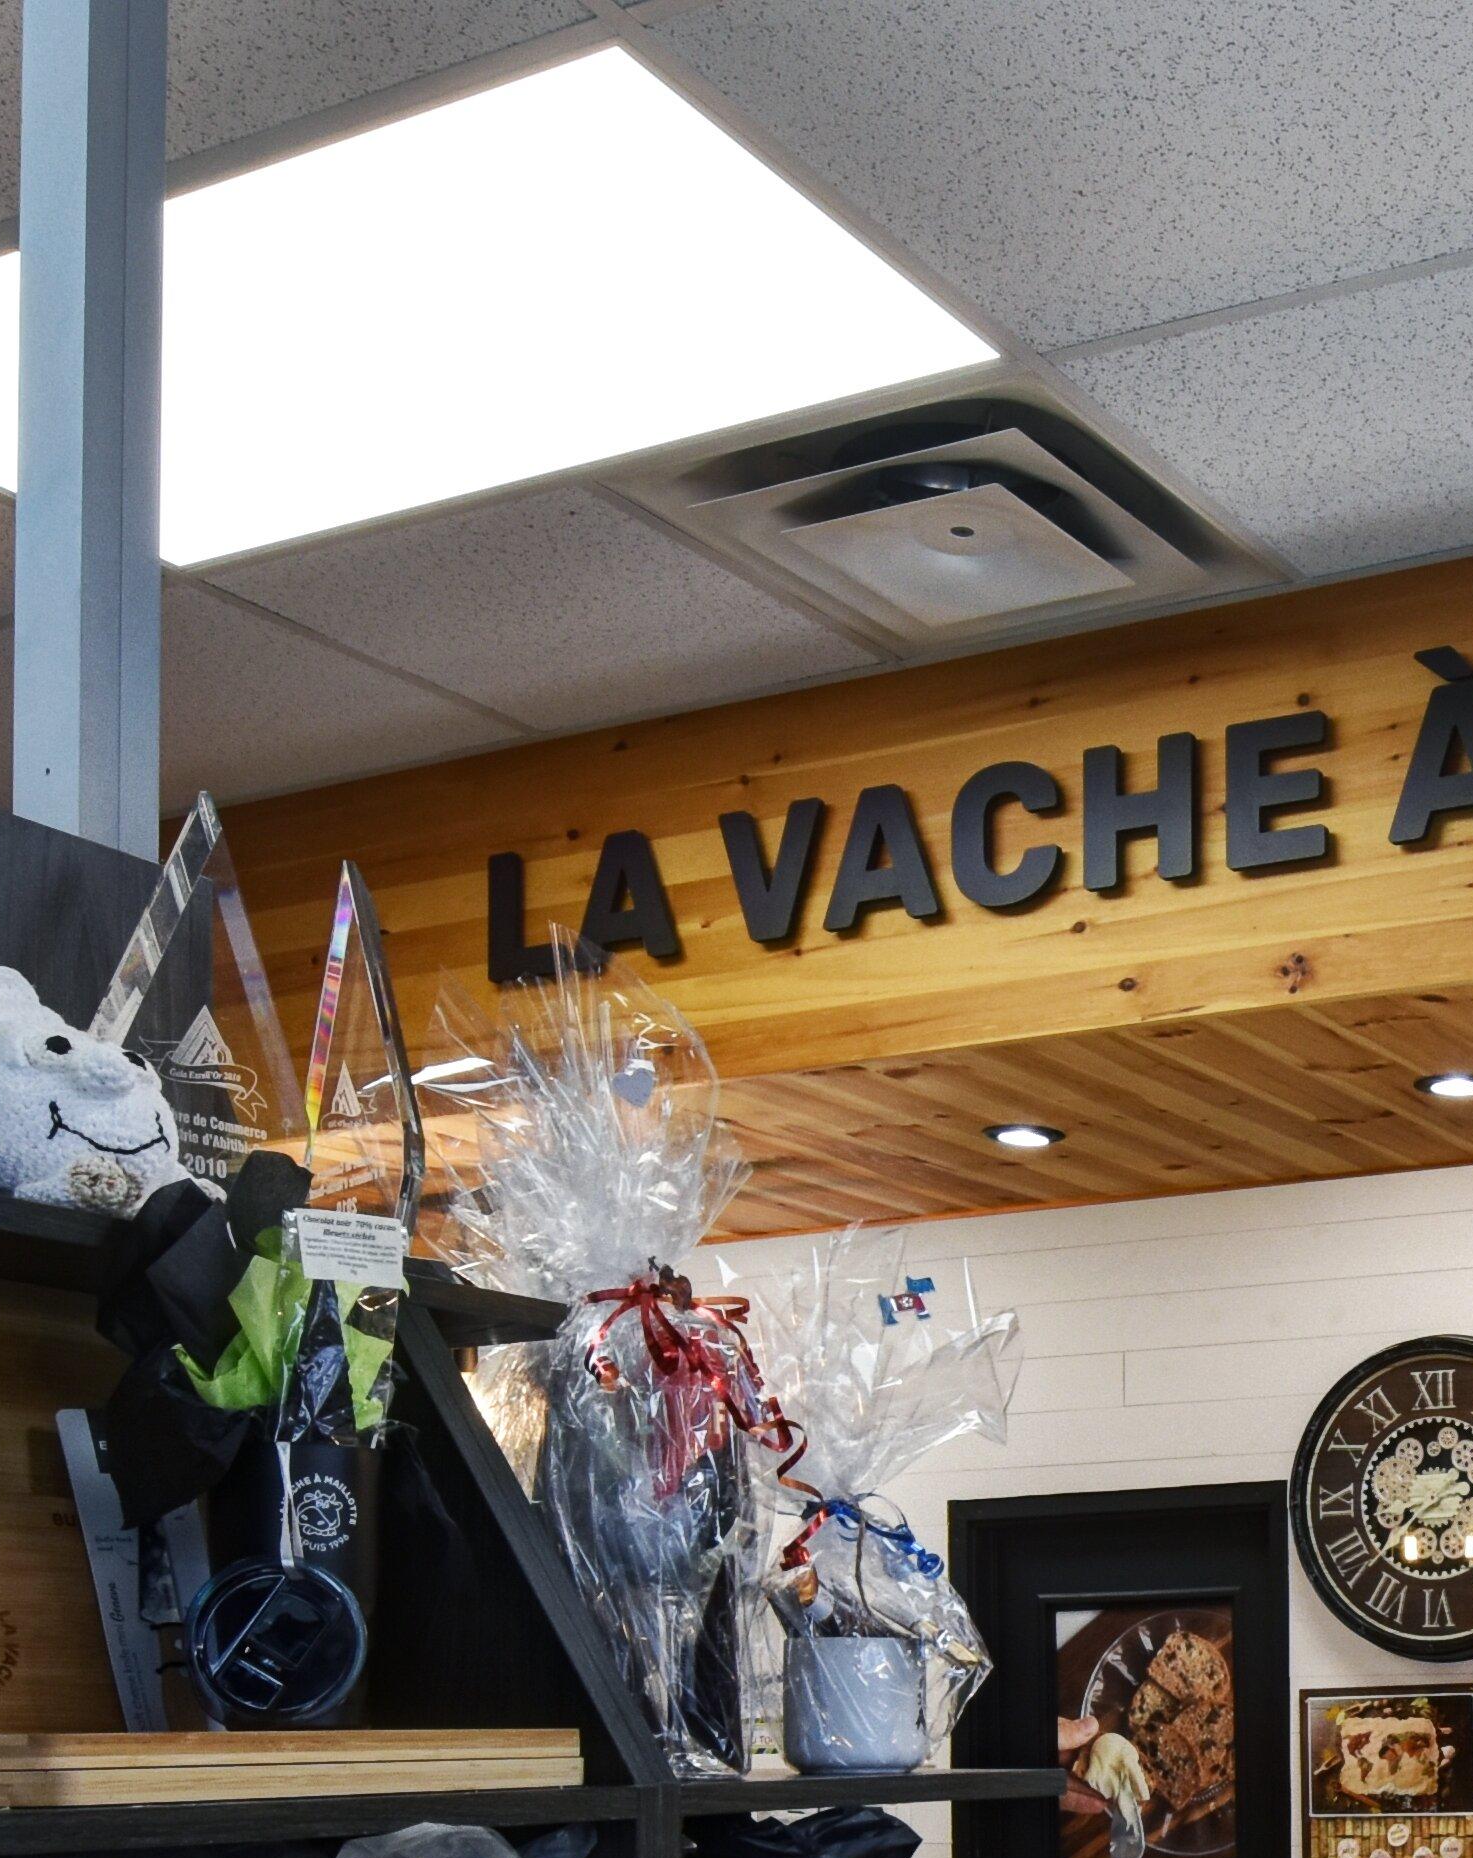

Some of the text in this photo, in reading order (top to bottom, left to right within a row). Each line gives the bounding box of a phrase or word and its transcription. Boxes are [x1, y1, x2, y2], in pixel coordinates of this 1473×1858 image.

[486, 827, 681, 982] LA
[718, 708, 1329, 943] VACHE
[193, 1112, 268, 1140] de Commerce
[185, 1155, 227, 1179] 2010
[324, 1475, 358, 1526] MAILLOTTE
[329, 1534, 351, 1550] 1996
